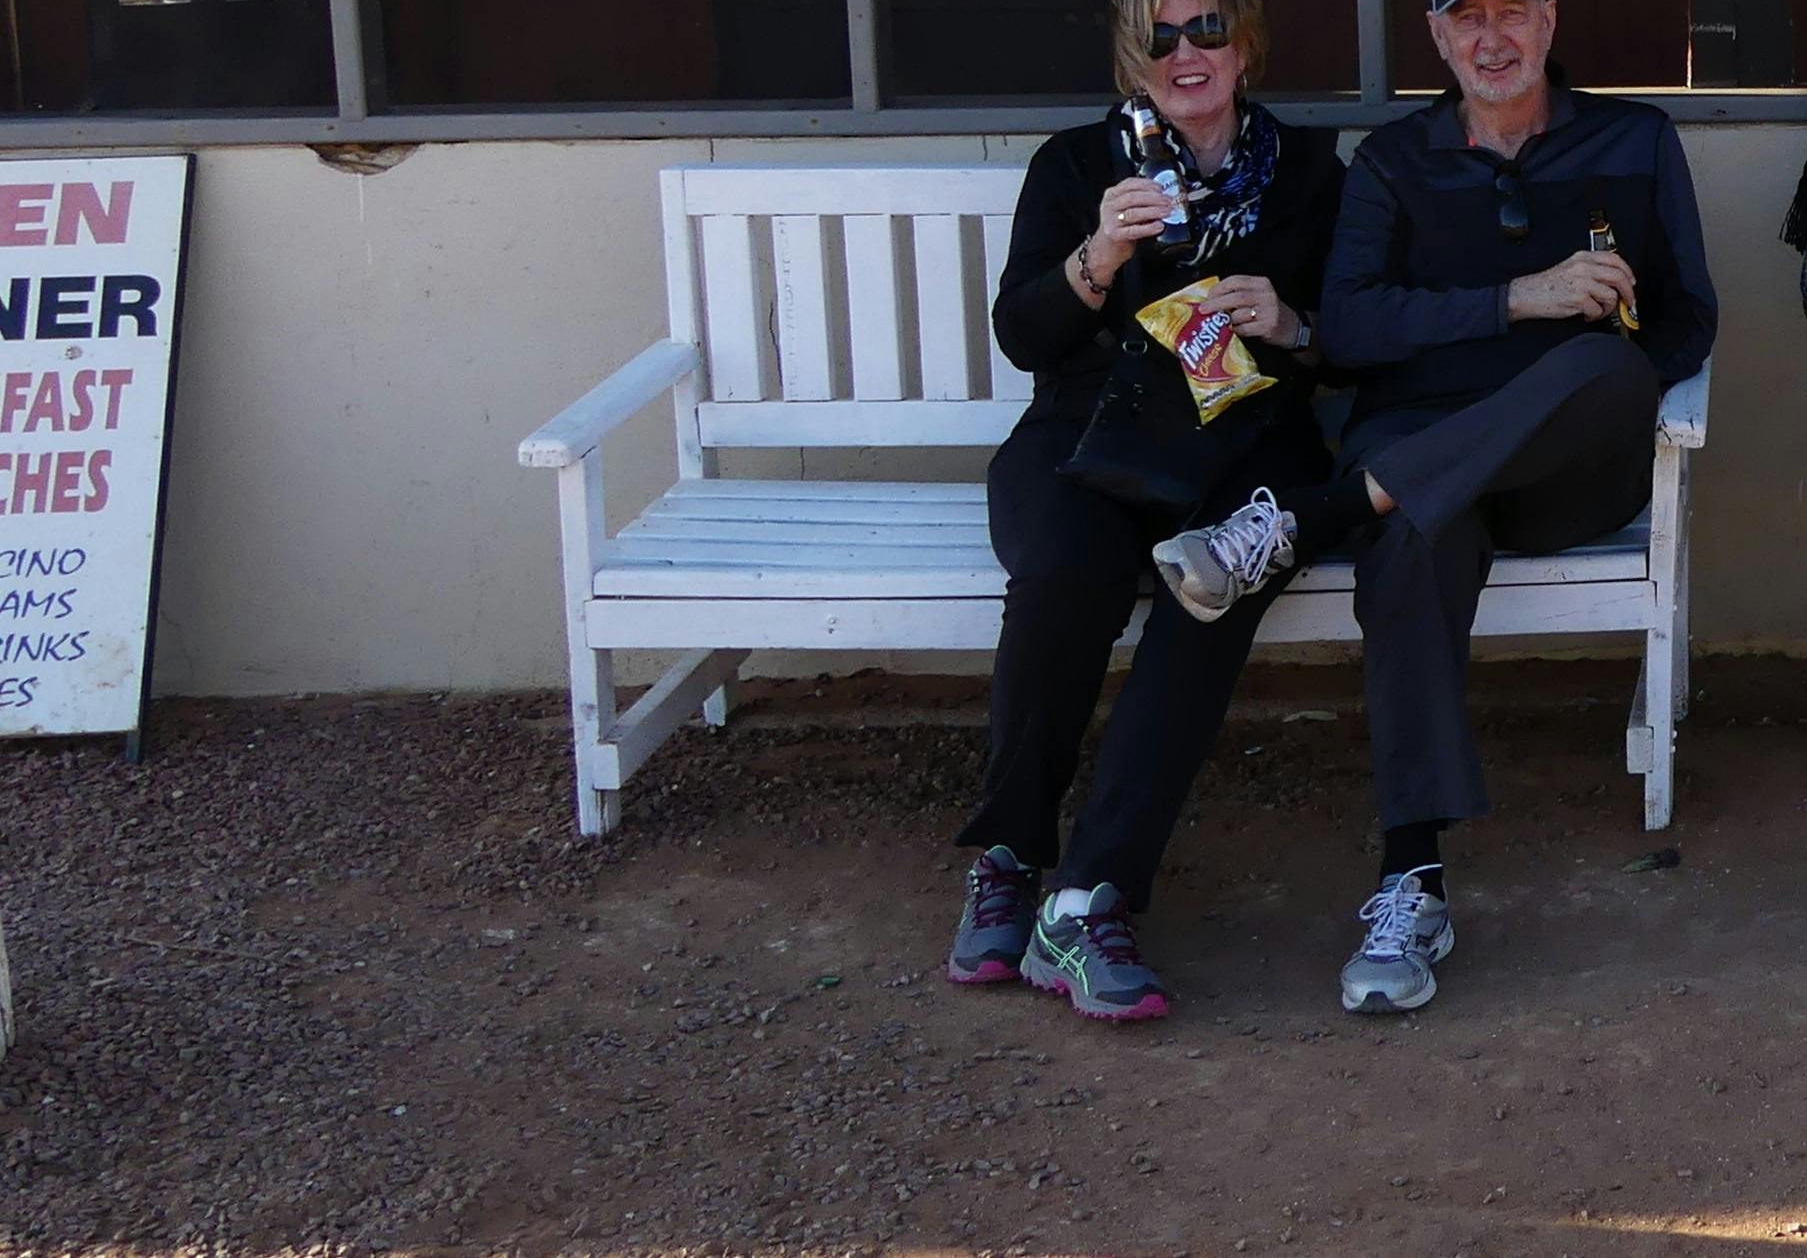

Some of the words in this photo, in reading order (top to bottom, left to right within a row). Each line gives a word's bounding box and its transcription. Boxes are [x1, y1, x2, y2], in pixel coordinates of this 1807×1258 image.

[0, 182, 133, 246] EN
[1178, 310, 1232, 371] Twisties
[0, 369, 133, 433] FAST
[0, 588, 77, 619] AMS
[0, 630, 90, 664] INKS
